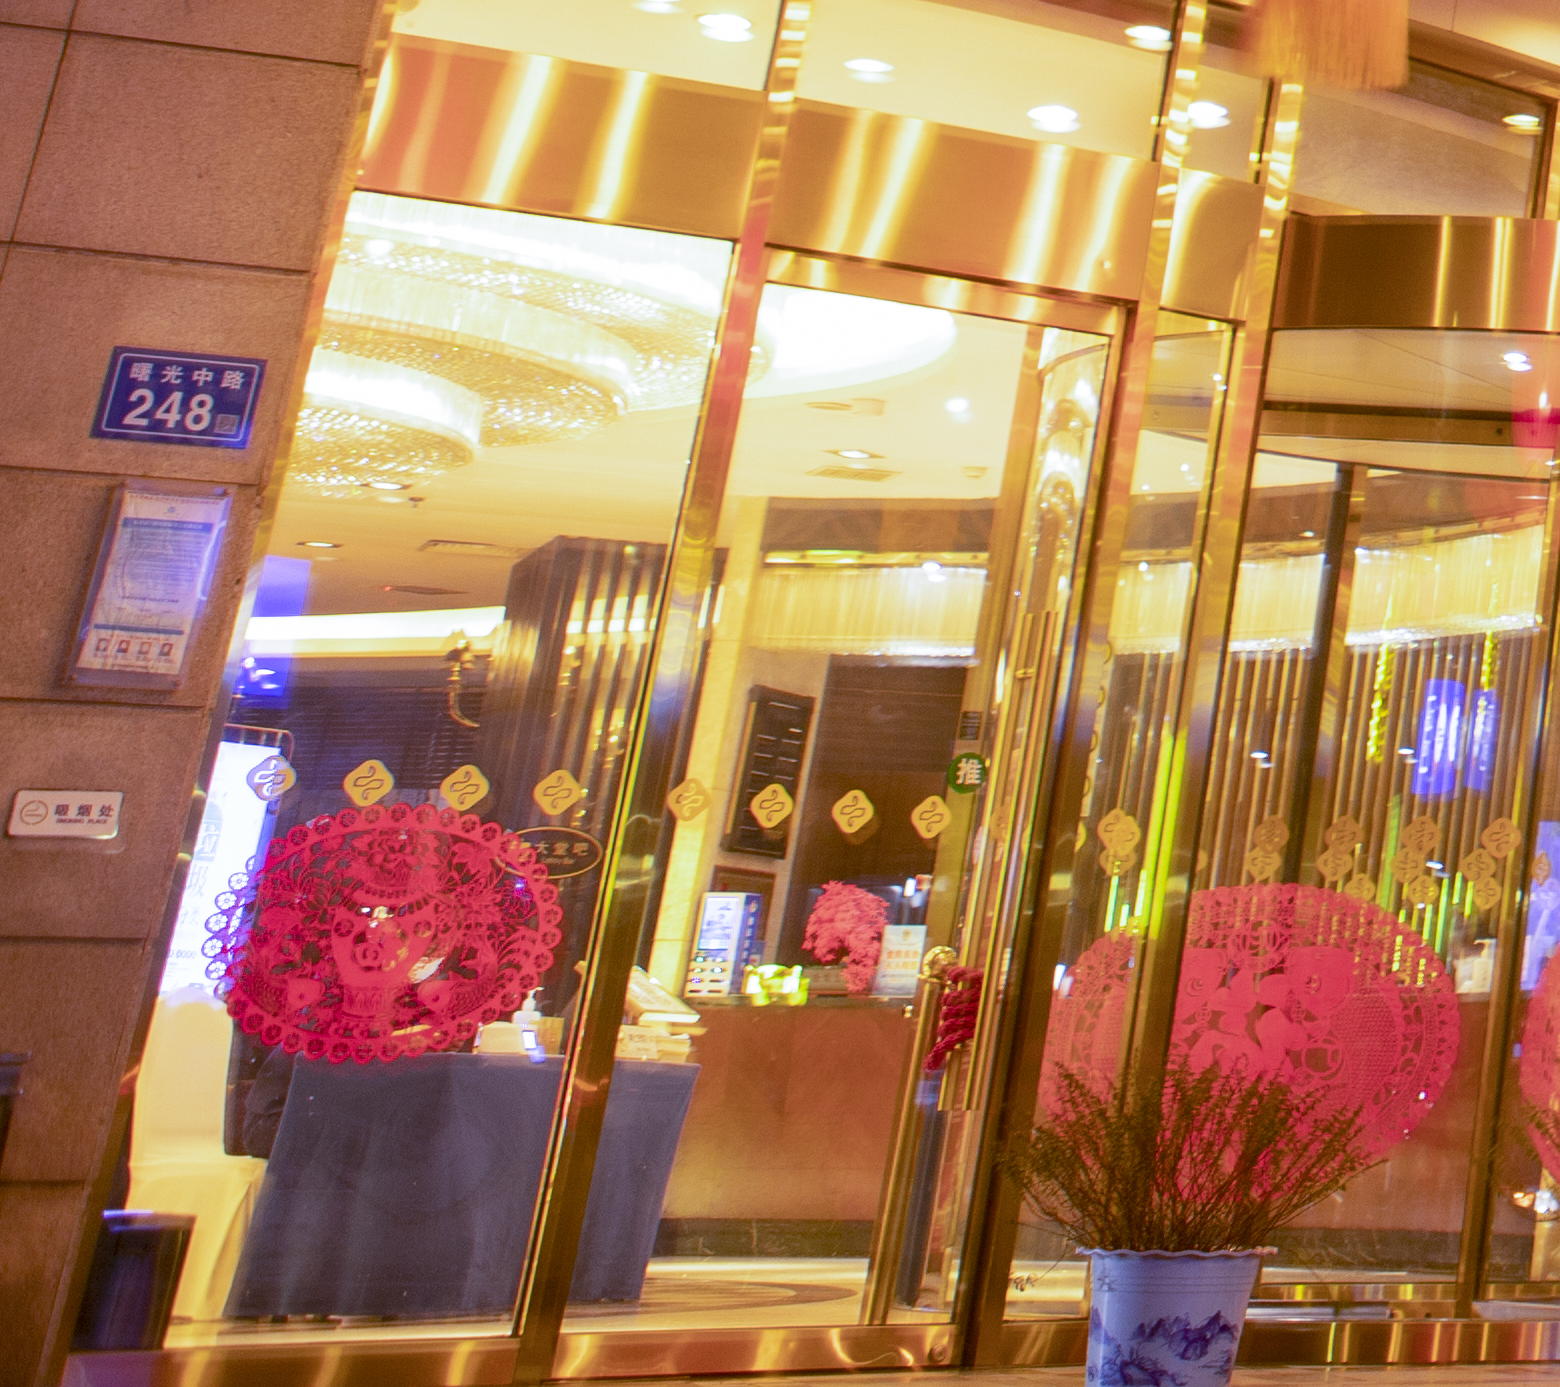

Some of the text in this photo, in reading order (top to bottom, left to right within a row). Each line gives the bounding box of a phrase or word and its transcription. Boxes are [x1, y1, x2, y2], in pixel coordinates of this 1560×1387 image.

[129, 362, 245, 390] 曙光中路
[122, 388, 214, 431] 248
[956, 758, 982, 784] 推
